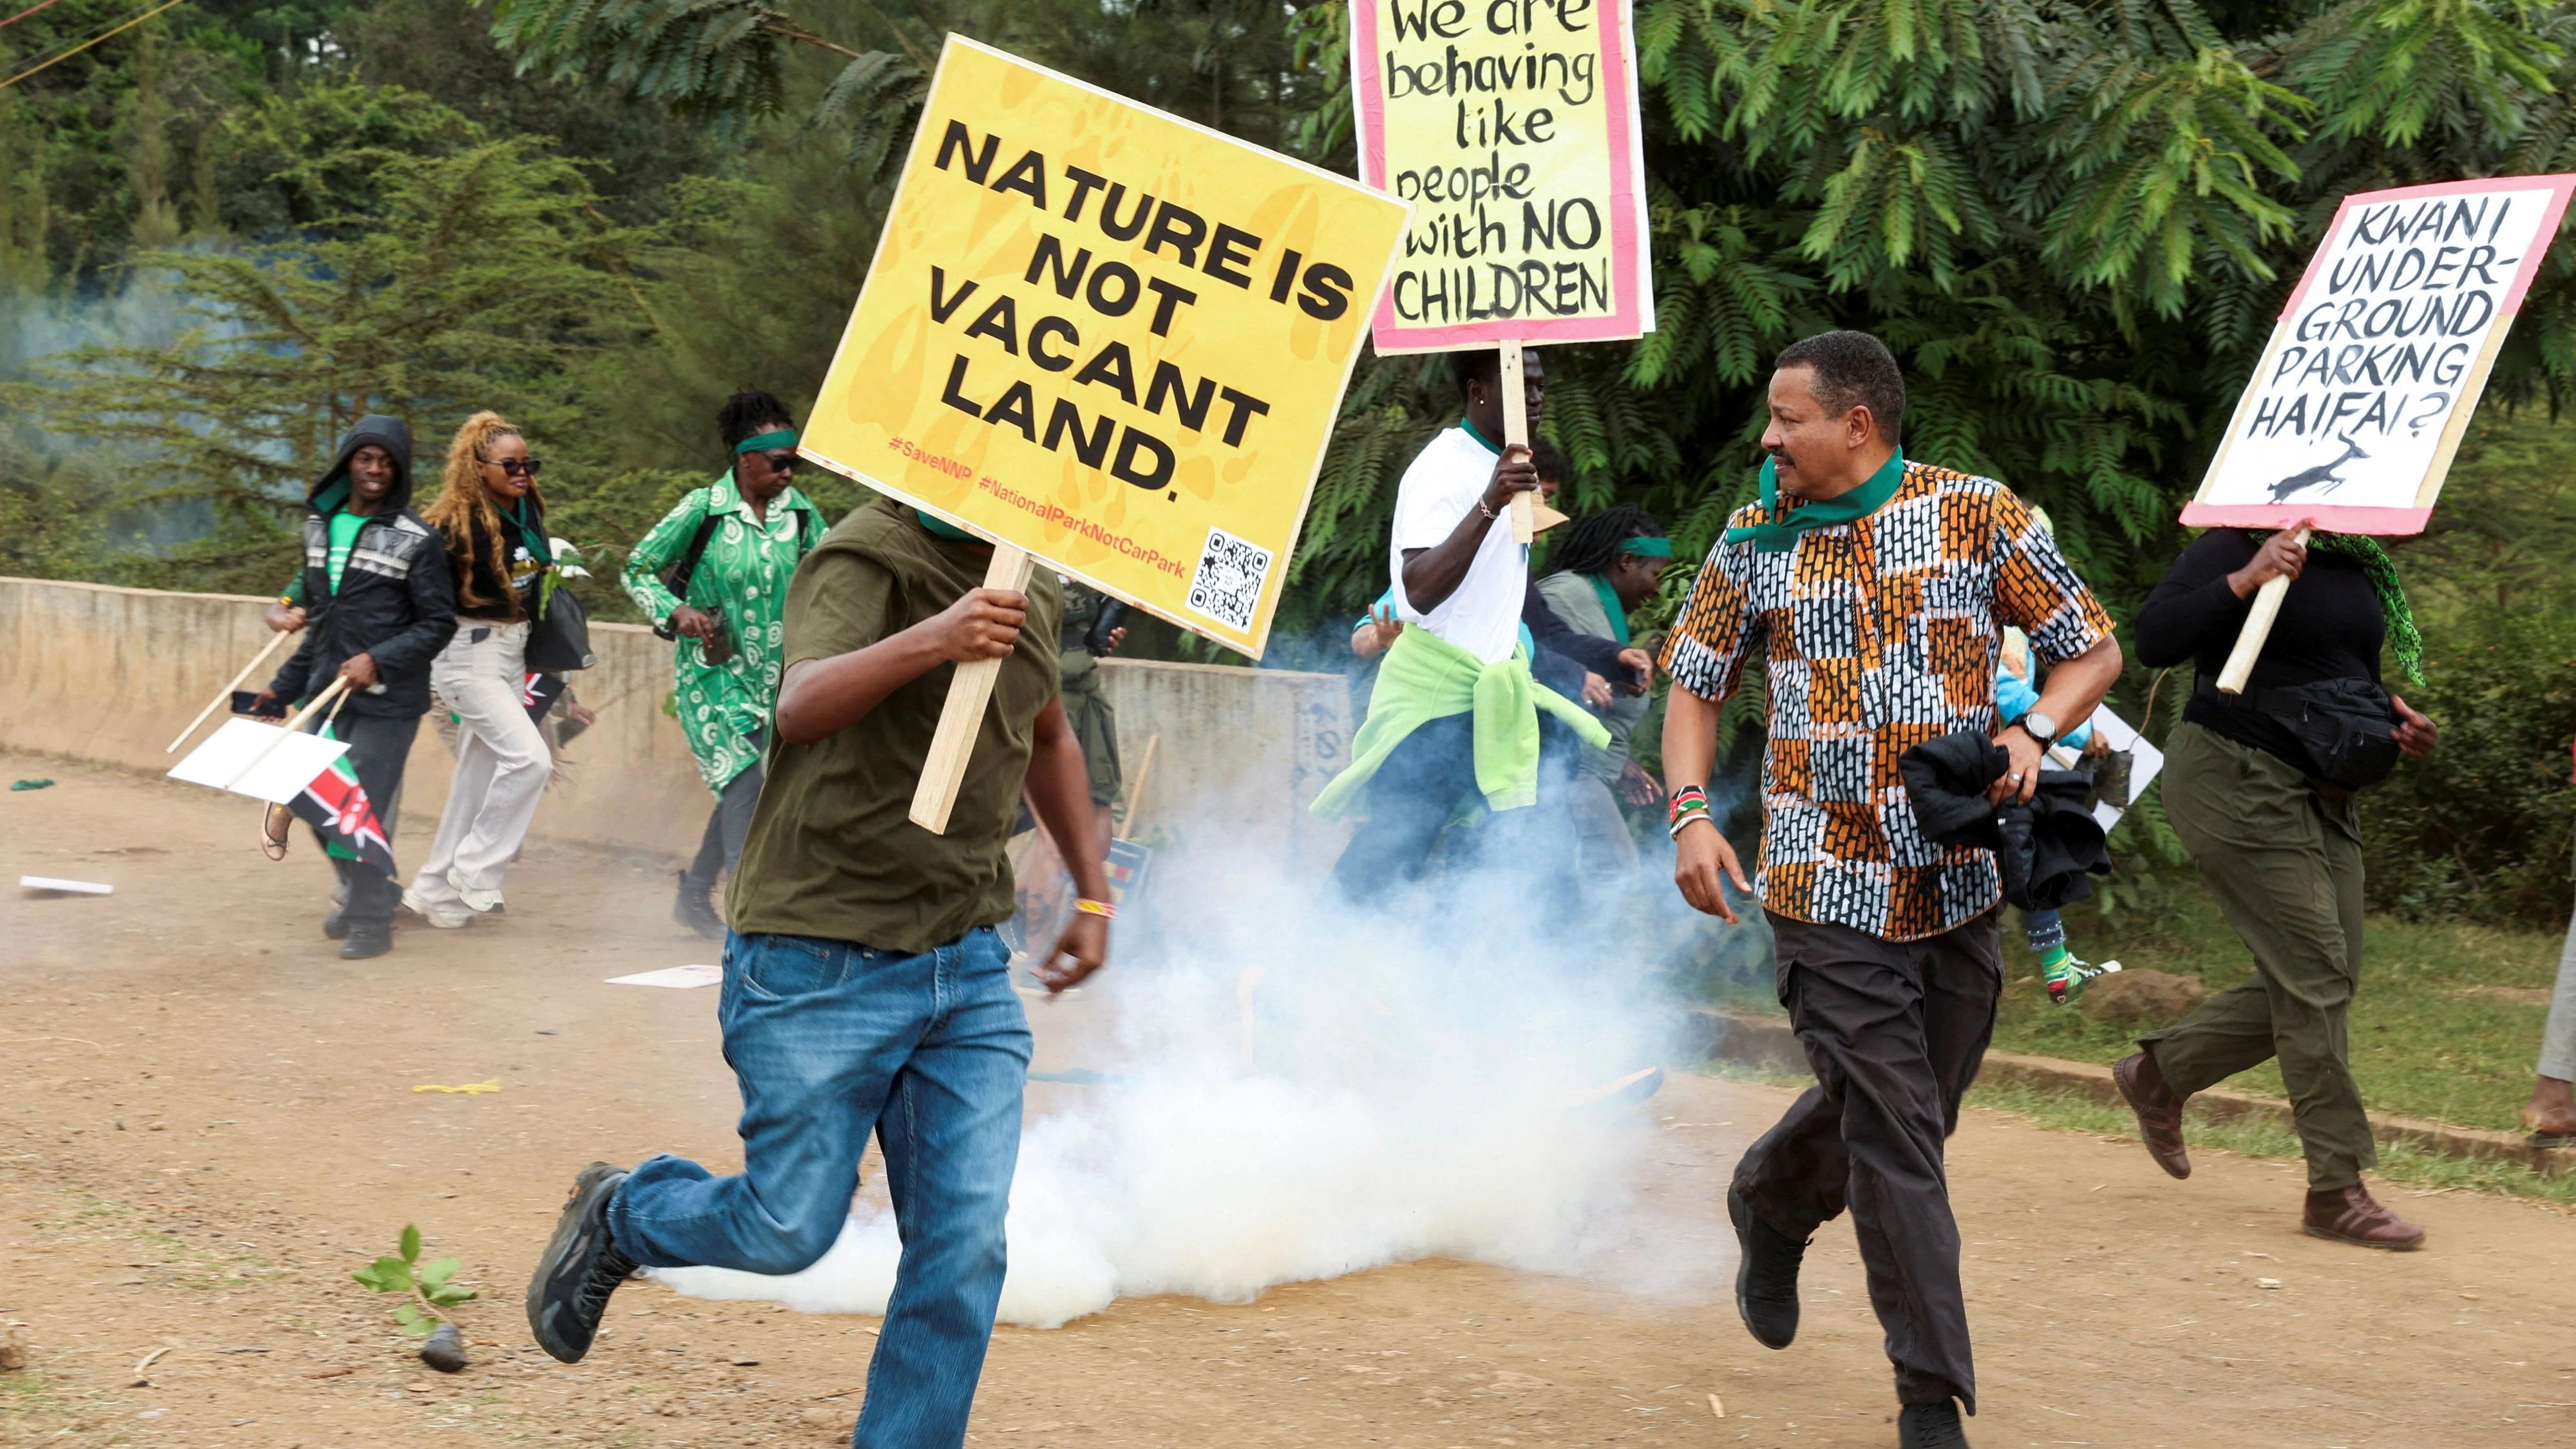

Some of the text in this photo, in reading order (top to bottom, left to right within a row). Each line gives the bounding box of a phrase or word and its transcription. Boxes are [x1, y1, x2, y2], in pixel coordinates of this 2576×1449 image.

[1486, 0, 1591, 35] are
[1386, 44, 1595, 106] behaving
[1457, 97, 1555, 149] like
[1397, 149, 1535, 217] people
[935, 120, 1352, 320] NATURE IS
[1406, 198, 1601, 258] with NO
[2347, 196, 2511, 251] KWANI
[1025, 234, 1197, 337] NOT
[1394, 258, 1607, 323] CHILDREN
[2329, 245, 2519, 295] UNDER-
[2297, 290, 2494, 341] GROUND
[932, 266, 1269, 447] VACANT
[2272, 341, 2469, 389] PARKING
[942, 354, 1177, 501] LAND.
[888, 437, 1186, 579] #SaveNNP #NationalParkNotCarPark
